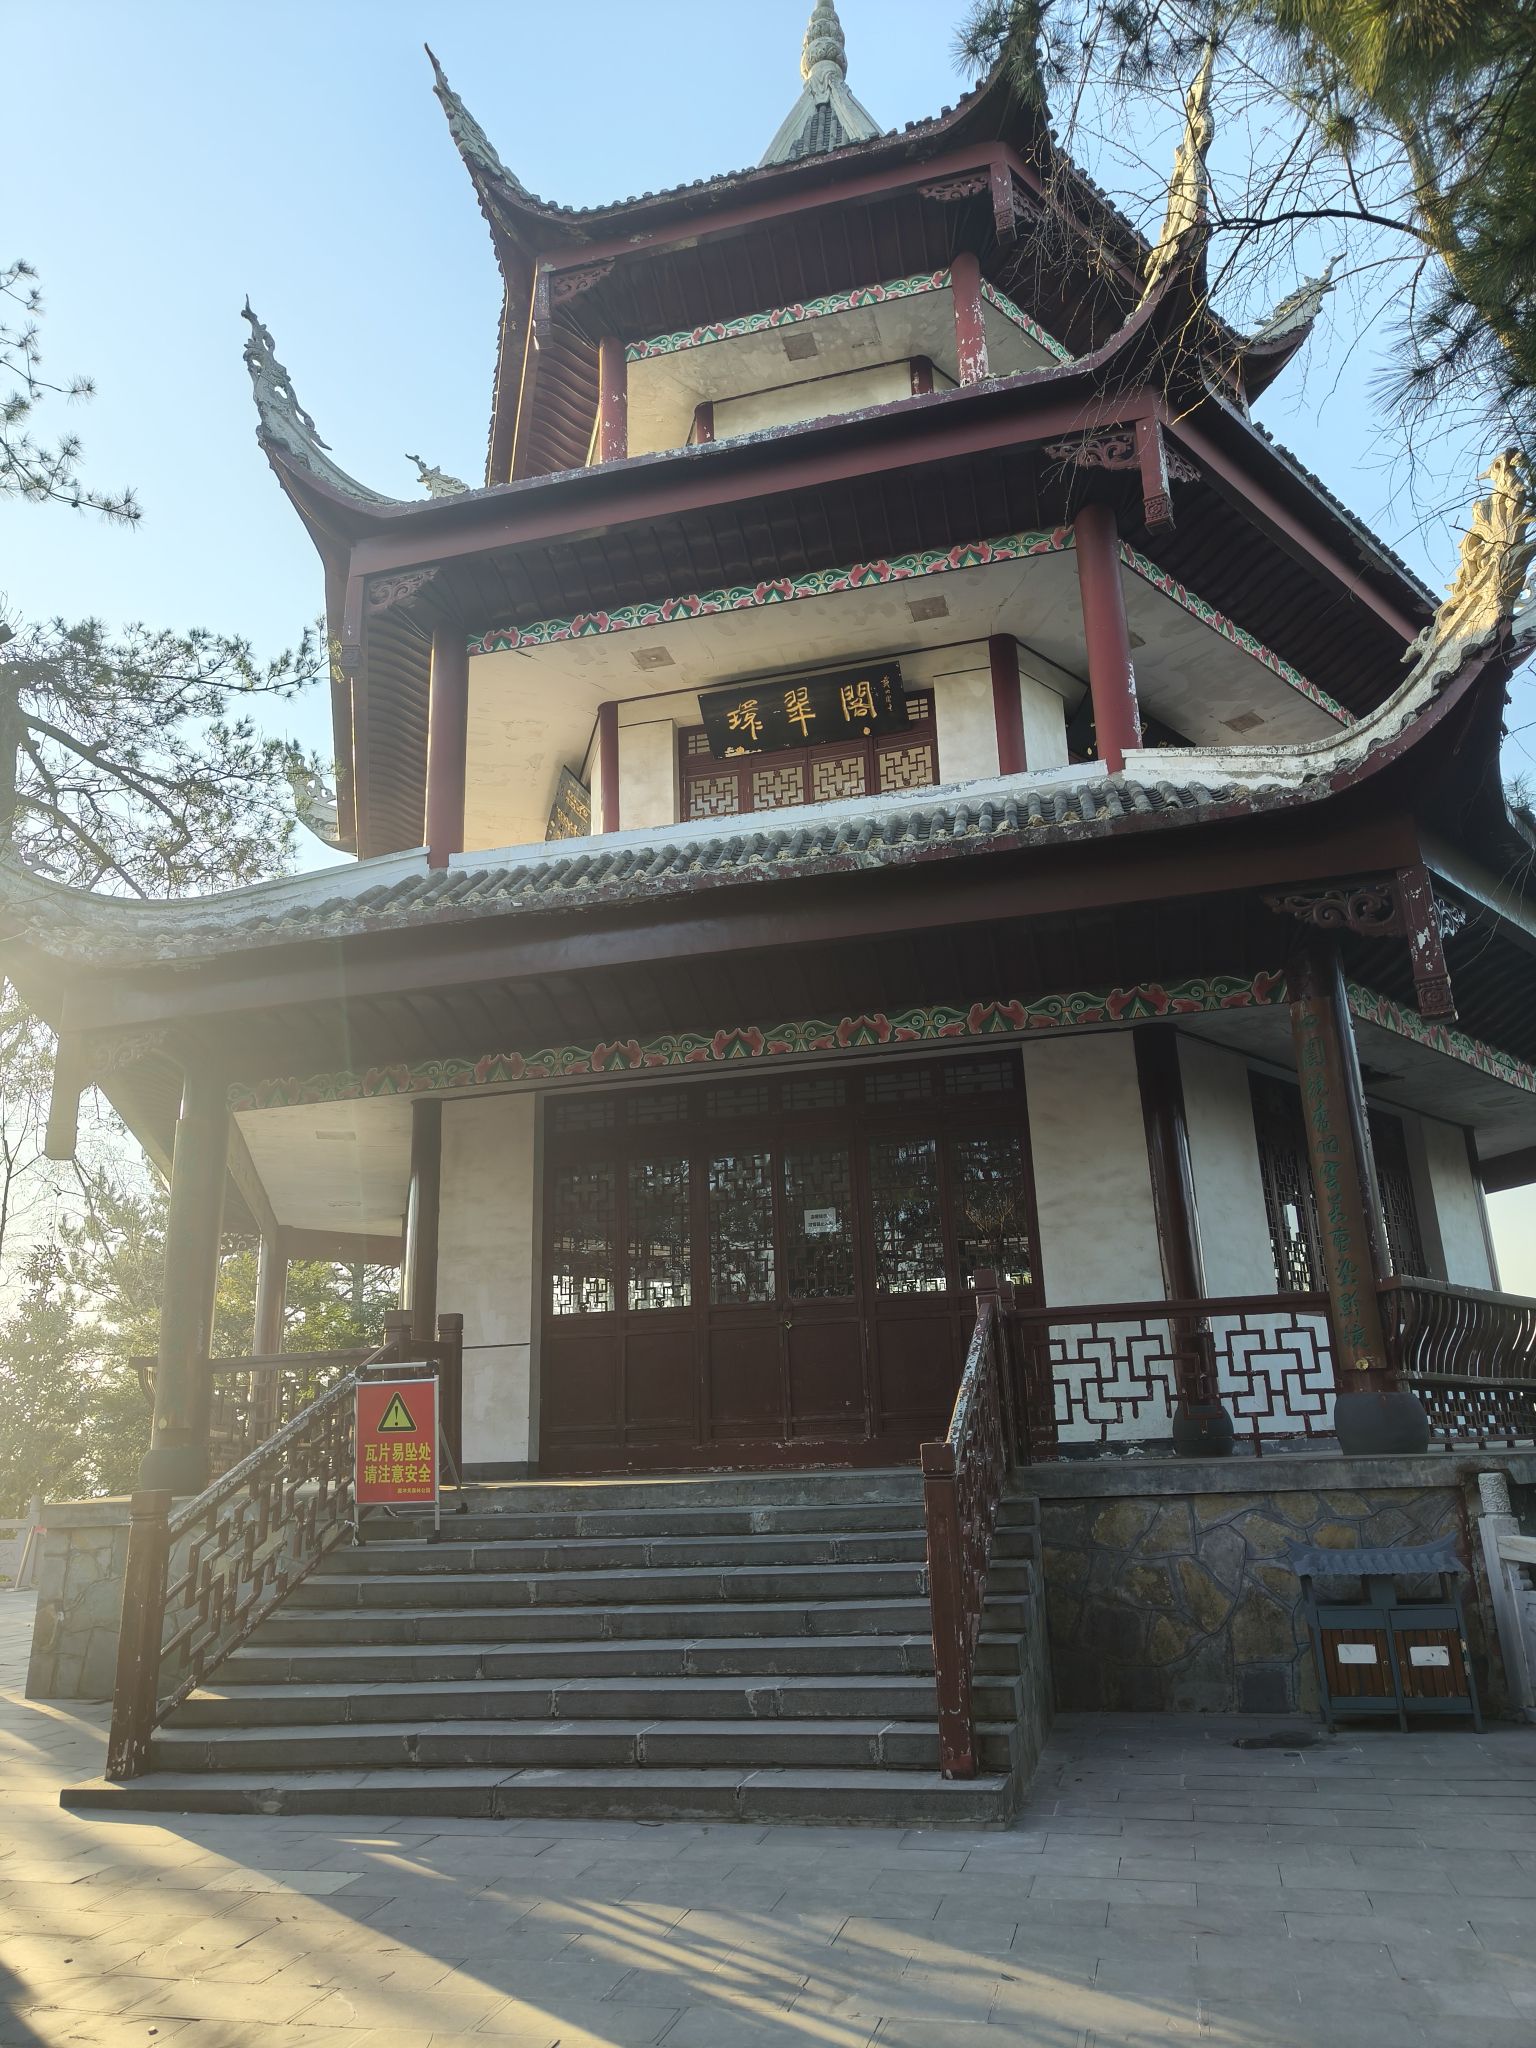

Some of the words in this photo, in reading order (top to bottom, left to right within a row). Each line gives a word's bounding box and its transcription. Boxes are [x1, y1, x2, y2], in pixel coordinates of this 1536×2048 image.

[364, 1442, 431, 1462] 瓦片易坠处
[364, 1463, 431, 1484] 请注意安全
